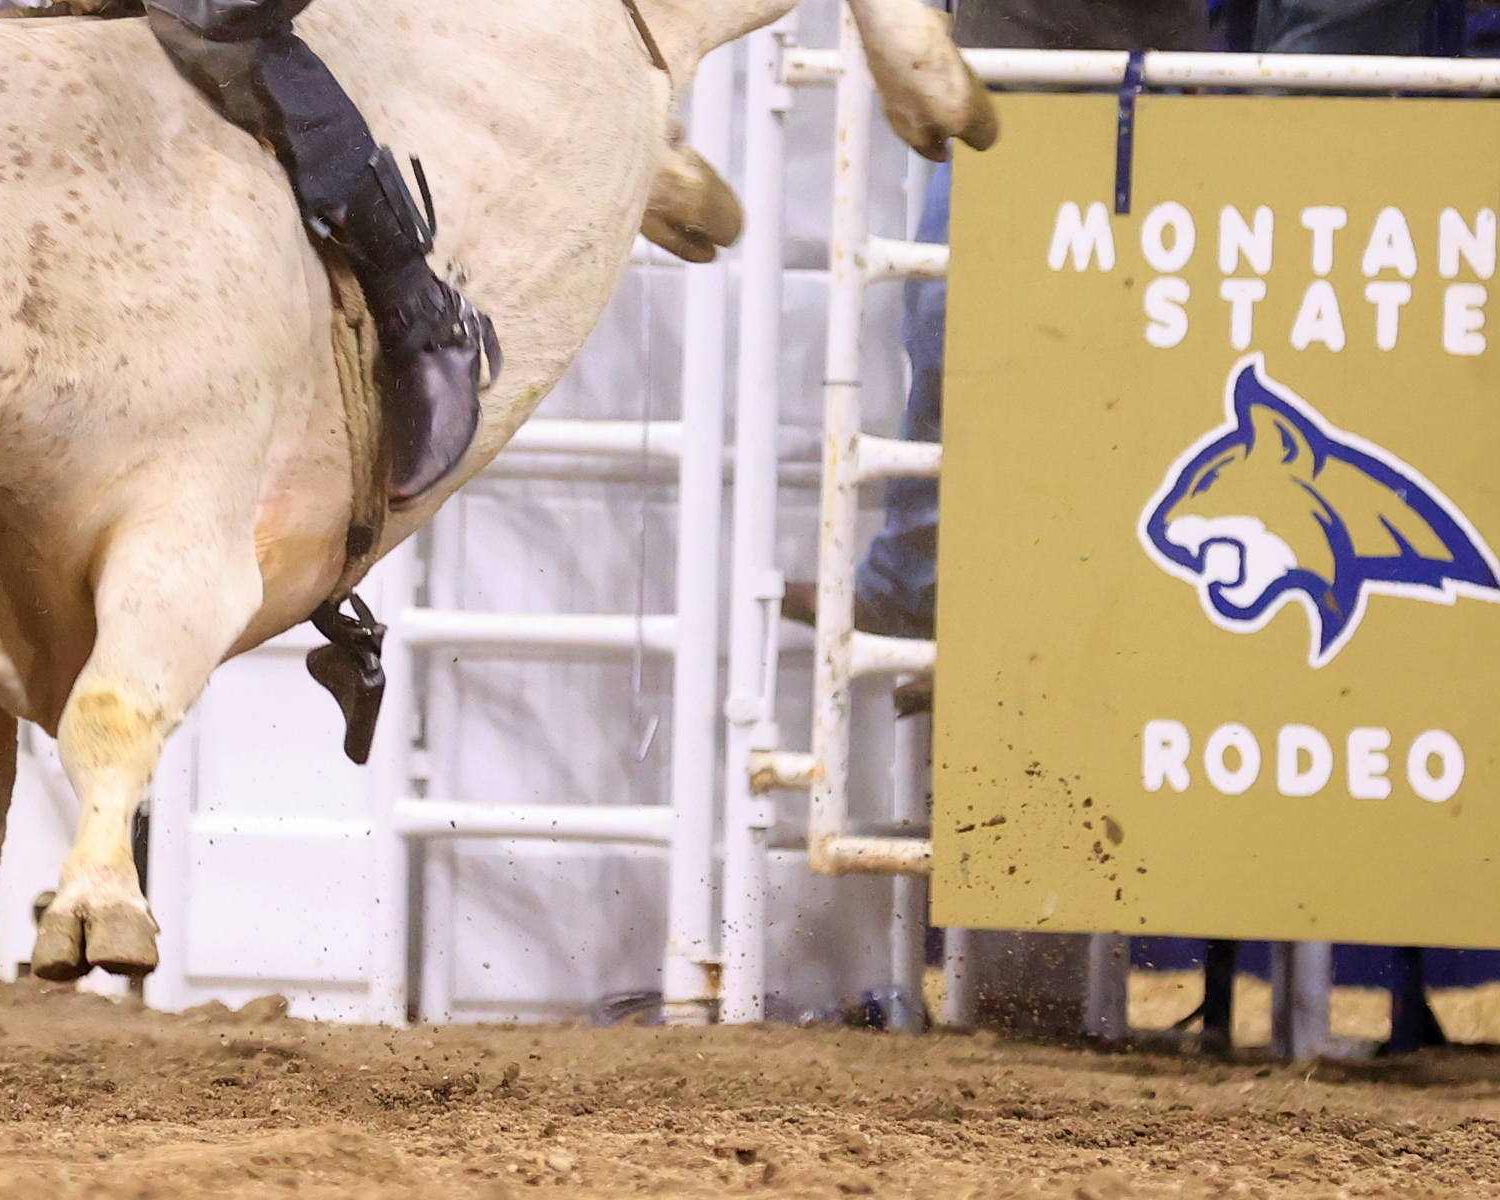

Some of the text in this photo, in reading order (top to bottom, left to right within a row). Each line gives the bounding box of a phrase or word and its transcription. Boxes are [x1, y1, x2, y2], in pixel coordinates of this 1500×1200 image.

[1047, 200, 1498, 280] MONTAN
[1143, 275, 1489, 356] STATE
[1142, 718, 1466, 803] RODEO
